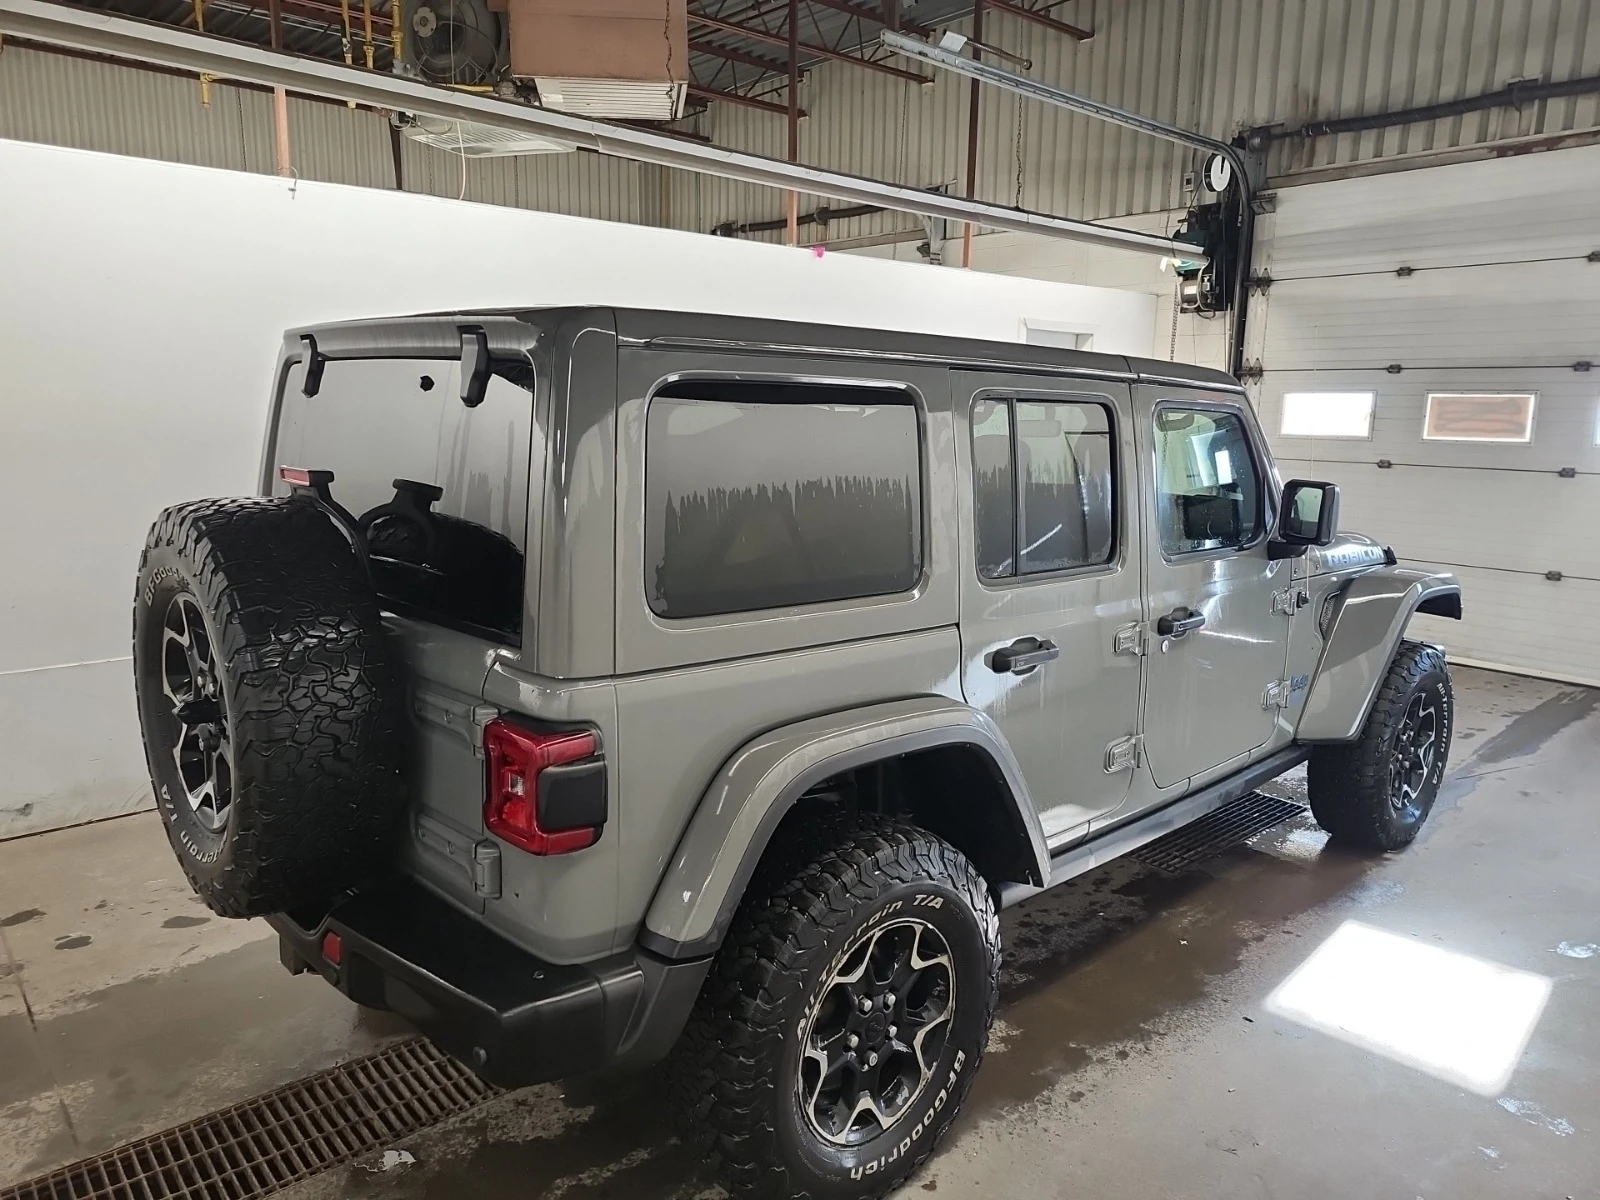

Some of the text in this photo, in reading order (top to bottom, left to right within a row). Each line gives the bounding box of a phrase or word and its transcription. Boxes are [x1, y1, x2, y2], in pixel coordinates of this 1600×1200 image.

[1327, 545, 1384, 567] RUBICON
[1432, 682, 1448, 784] All-Terrain T/A
[161, 784, 178, 825] T/A
[912, 894, 945, 910] T/A
[850, 1049, 966, 1182] BFGoodrich
